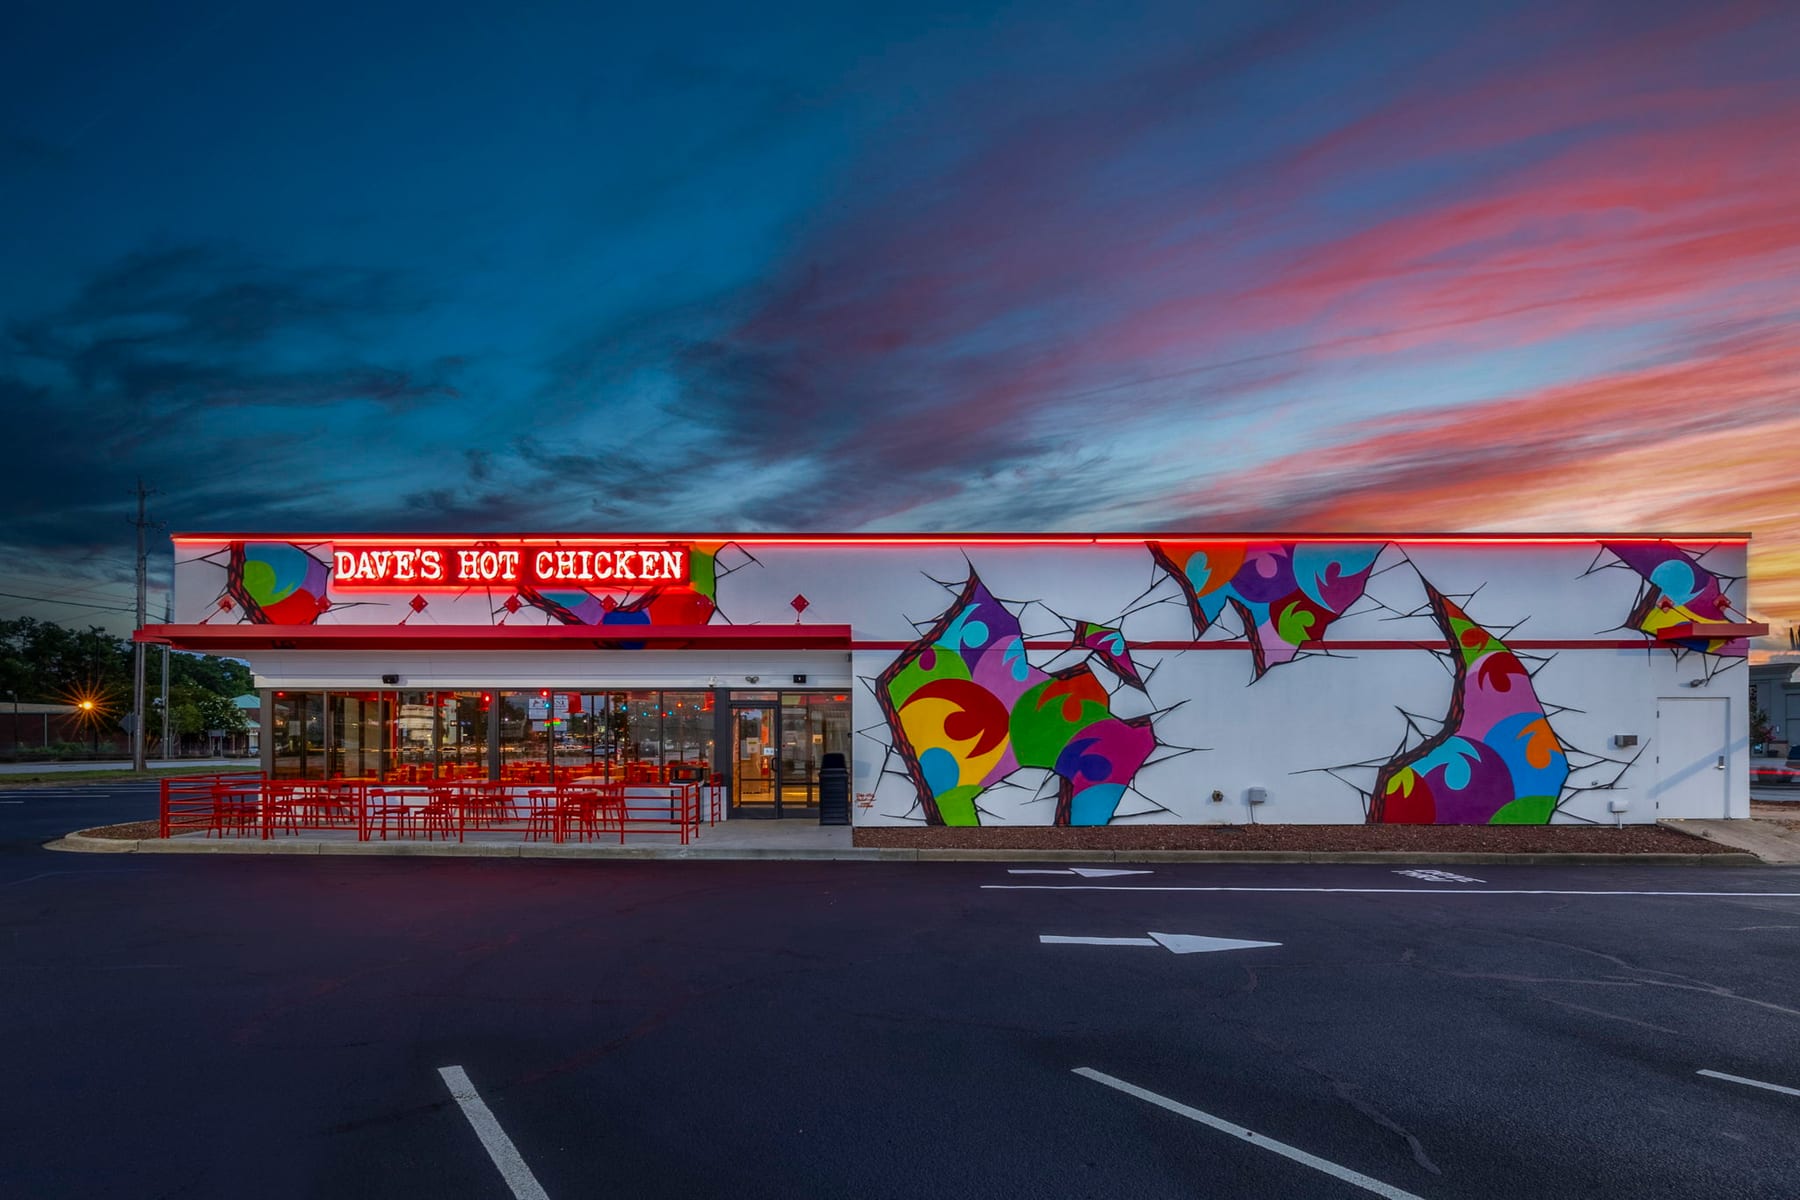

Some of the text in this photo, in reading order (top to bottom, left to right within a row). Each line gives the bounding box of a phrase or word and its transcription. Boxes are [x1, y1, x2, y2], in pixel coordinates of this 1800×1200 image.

[334, 549, 684, 580] DAVE'S HOT CHICKEN
